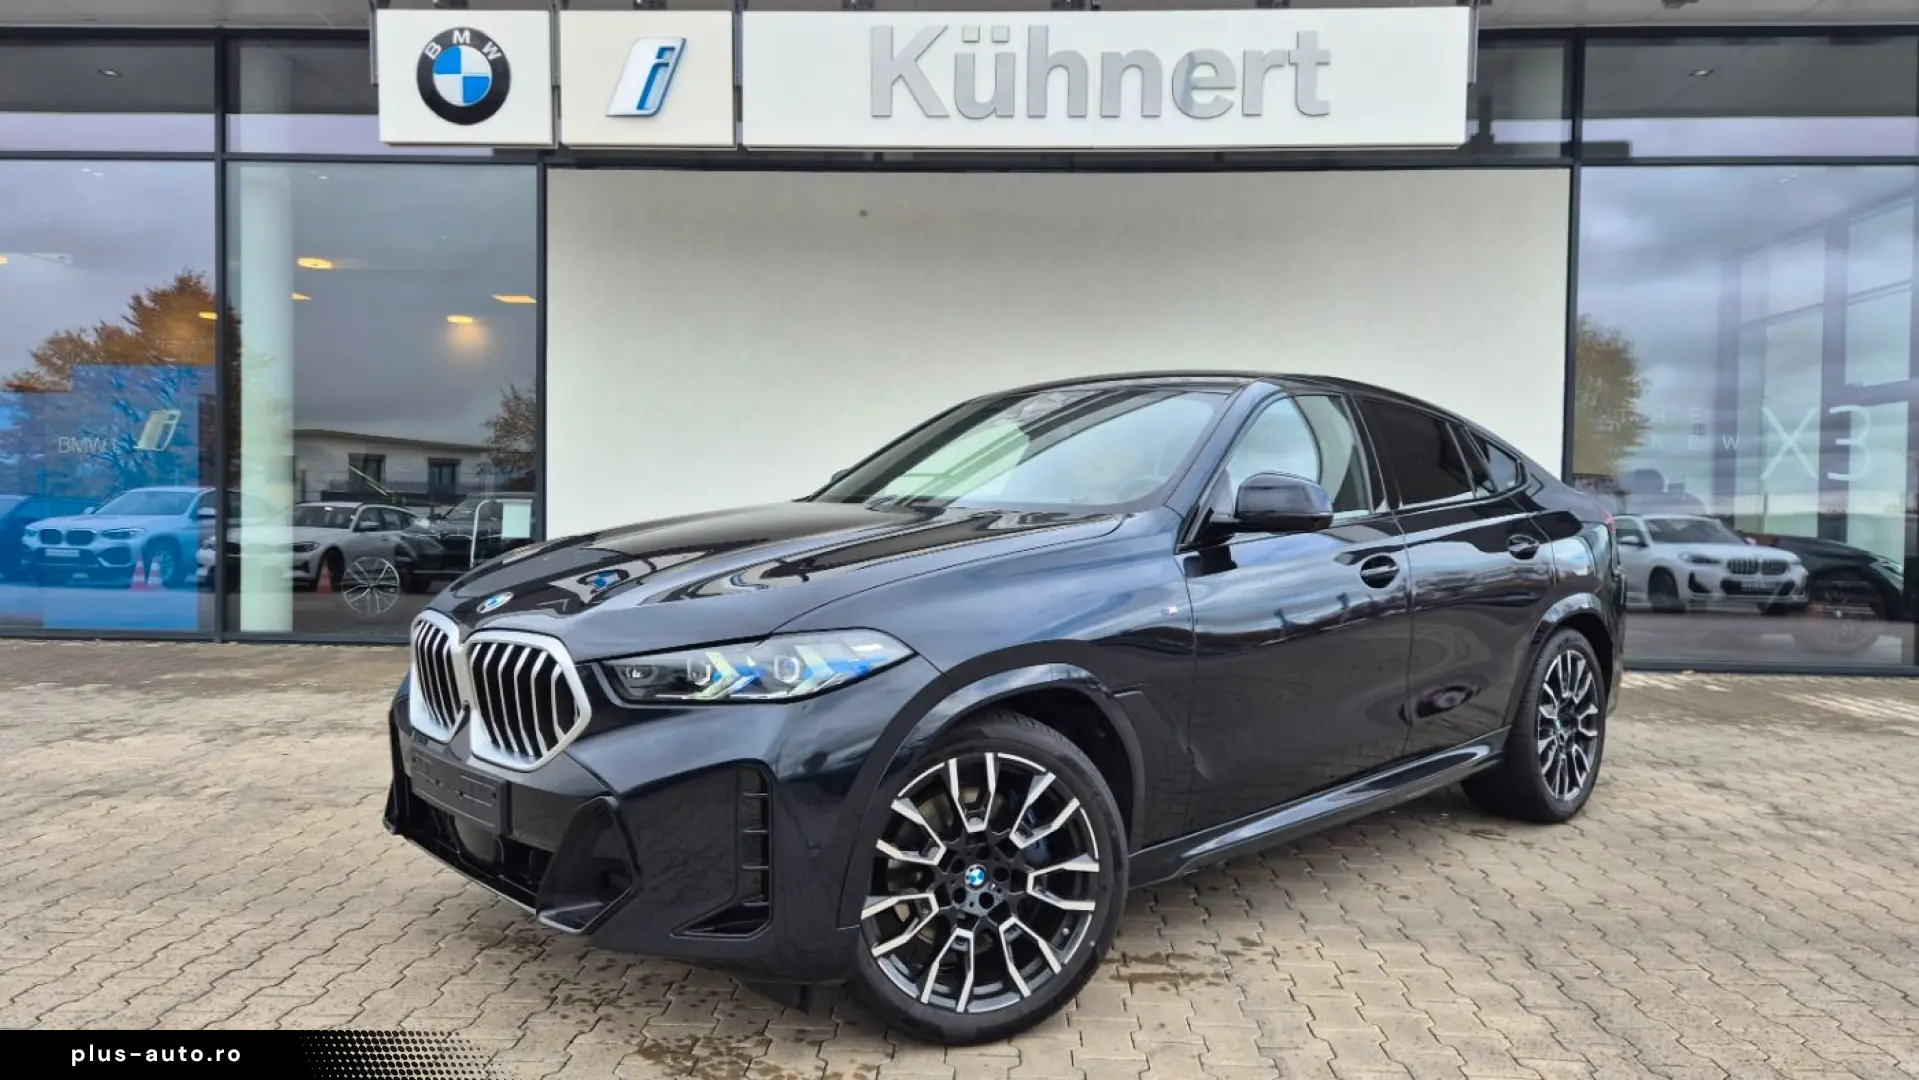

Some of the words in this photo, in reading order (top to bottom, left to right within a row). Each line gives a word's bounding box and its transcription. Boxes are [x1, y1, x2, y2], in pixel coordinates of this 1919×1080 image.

[424, 29, 503, 61] BMW
[870, 25, 1332, 119] Kühnert
[58, 436, 106, 453] BMW
[1761, 404, 1872, 481] X3
